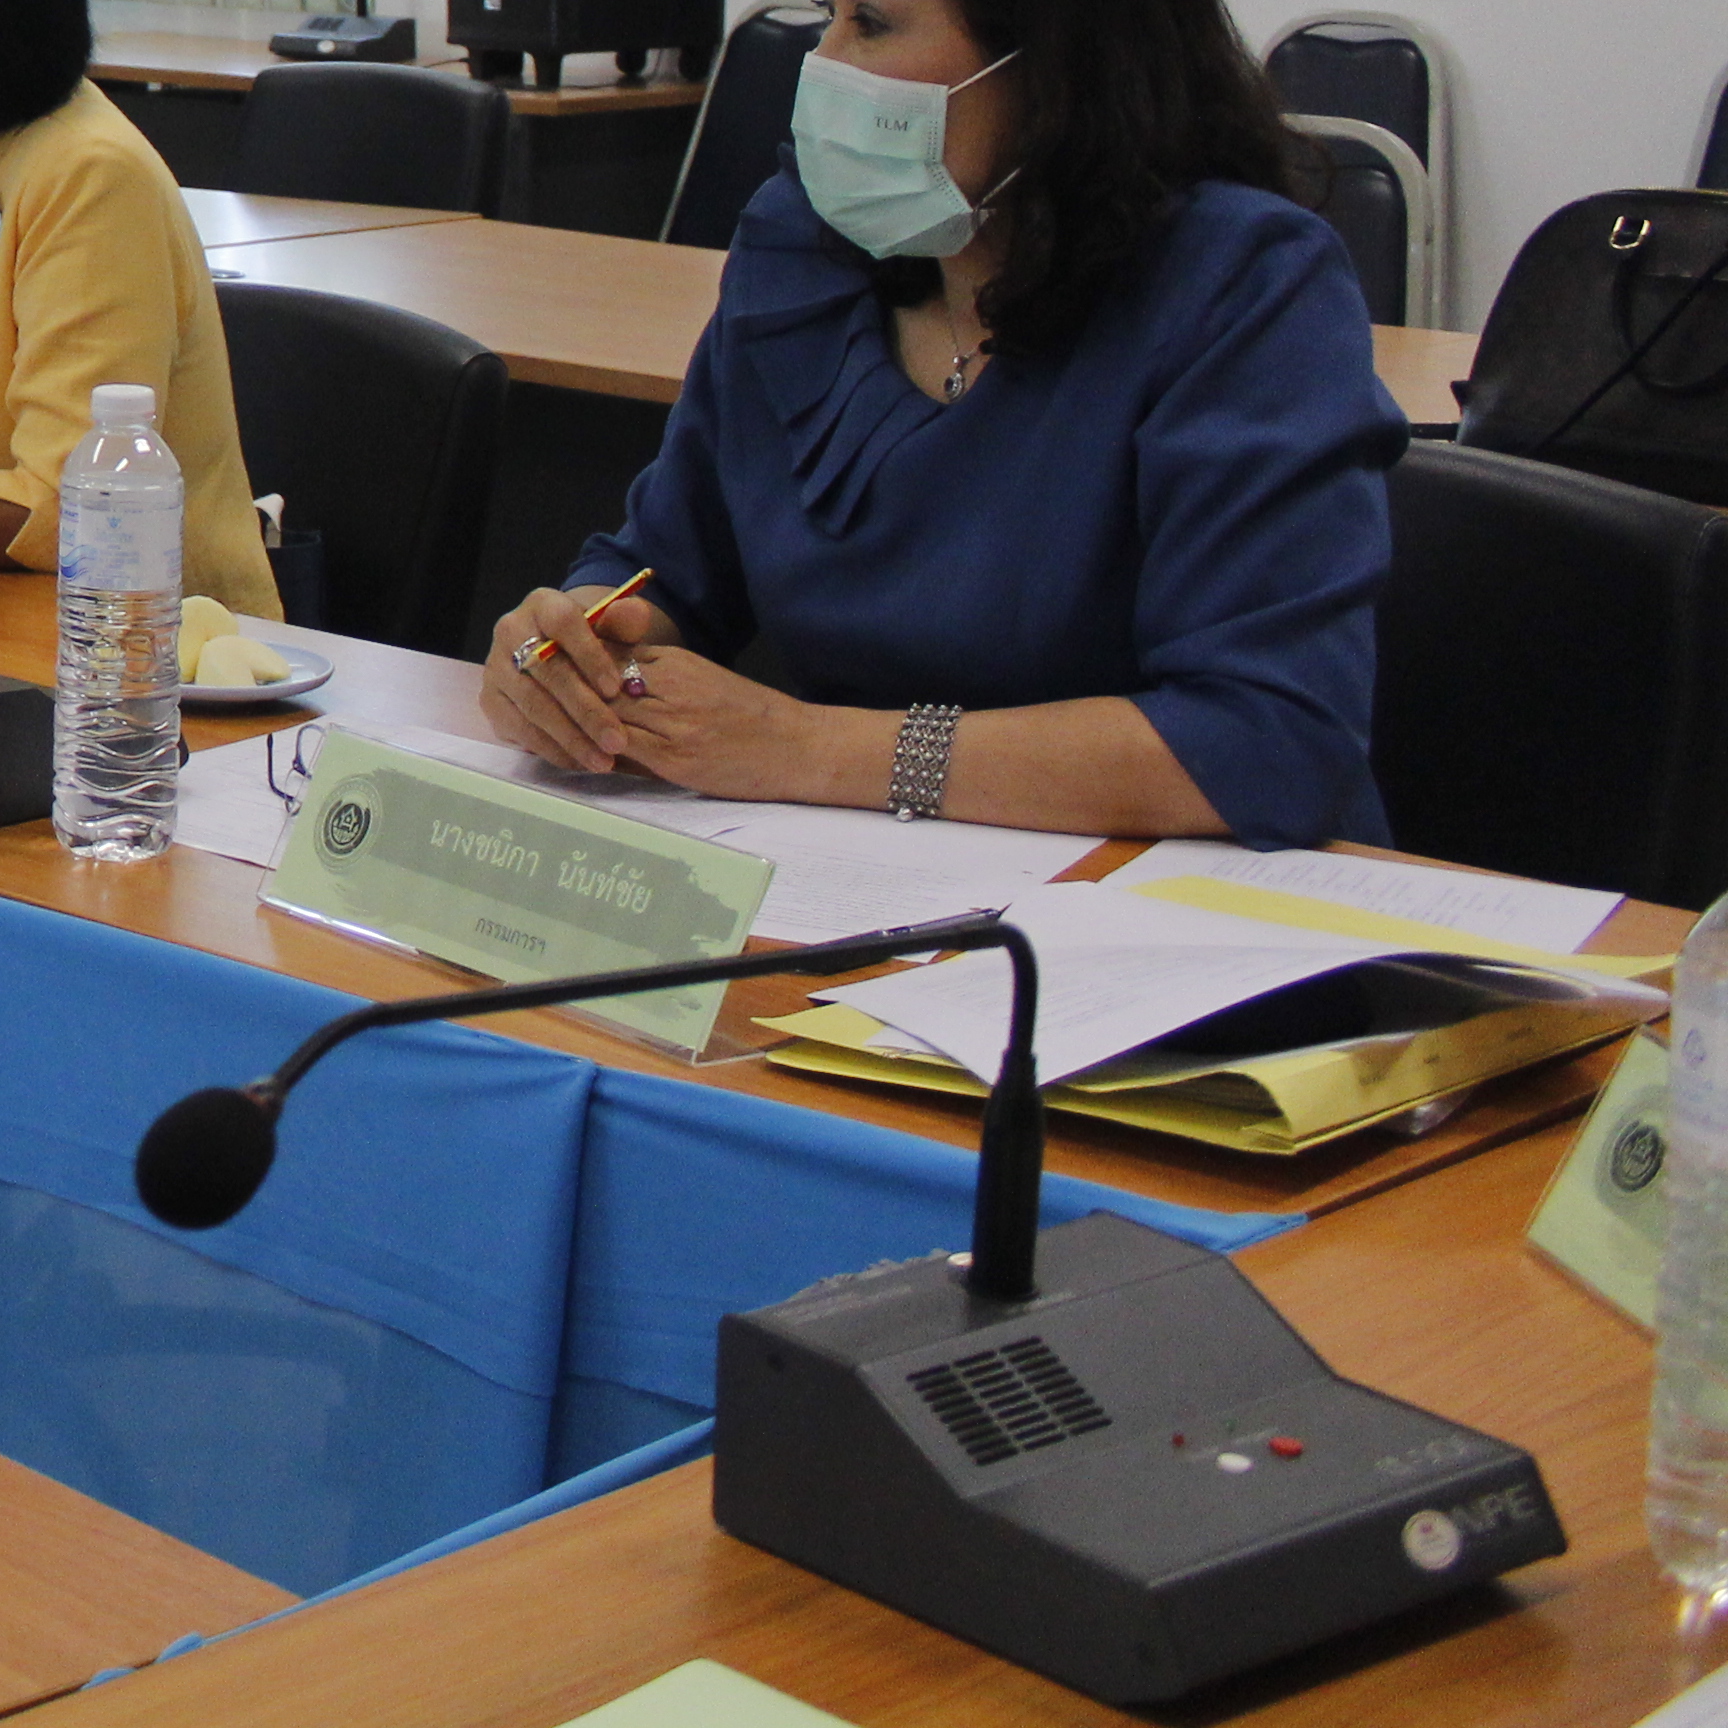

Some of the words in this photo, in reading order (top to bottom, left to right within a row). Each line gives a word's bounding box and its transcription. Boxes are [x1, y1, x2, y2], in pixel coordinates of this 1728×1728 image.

[873, 115, 909, 132] TLM
[430, 818, 541, 878] นางชนิกา
[557, 849, 654, 915] นันท์ชัย
[474, 917, 547, 955] กรรมการฯ
